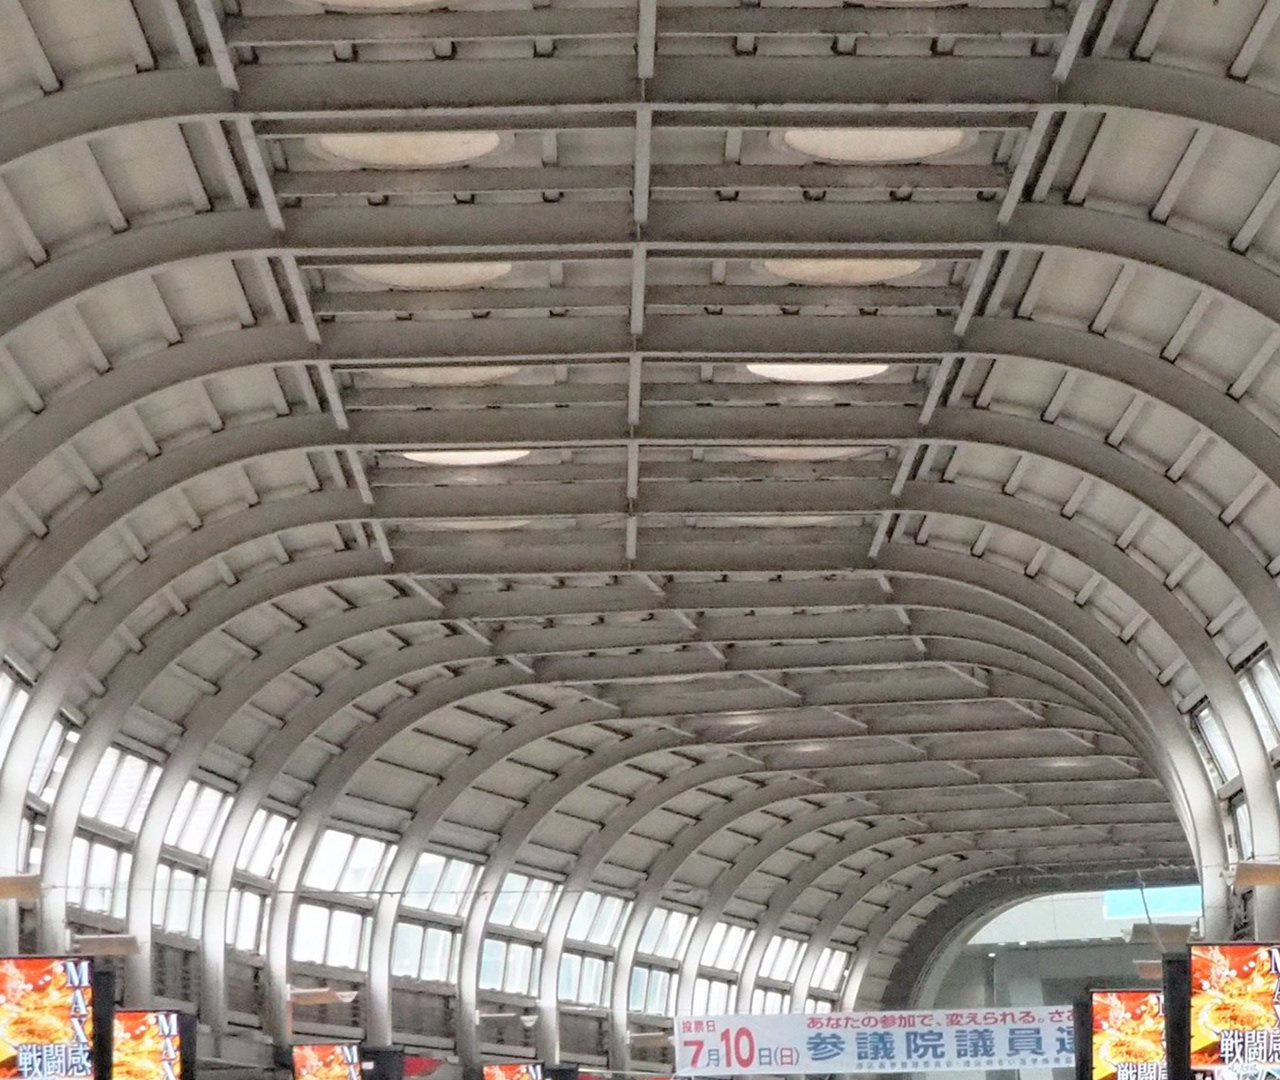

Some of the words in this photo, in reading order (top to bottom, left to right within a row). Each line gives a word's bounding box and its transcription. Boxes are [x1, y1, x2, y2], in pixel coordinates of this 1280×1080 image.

[65, 961, 90, 1044] MAX
[682, 1020, 715, 1033] 投票日
[17, 1044, 91, 1078] 戦闘感
